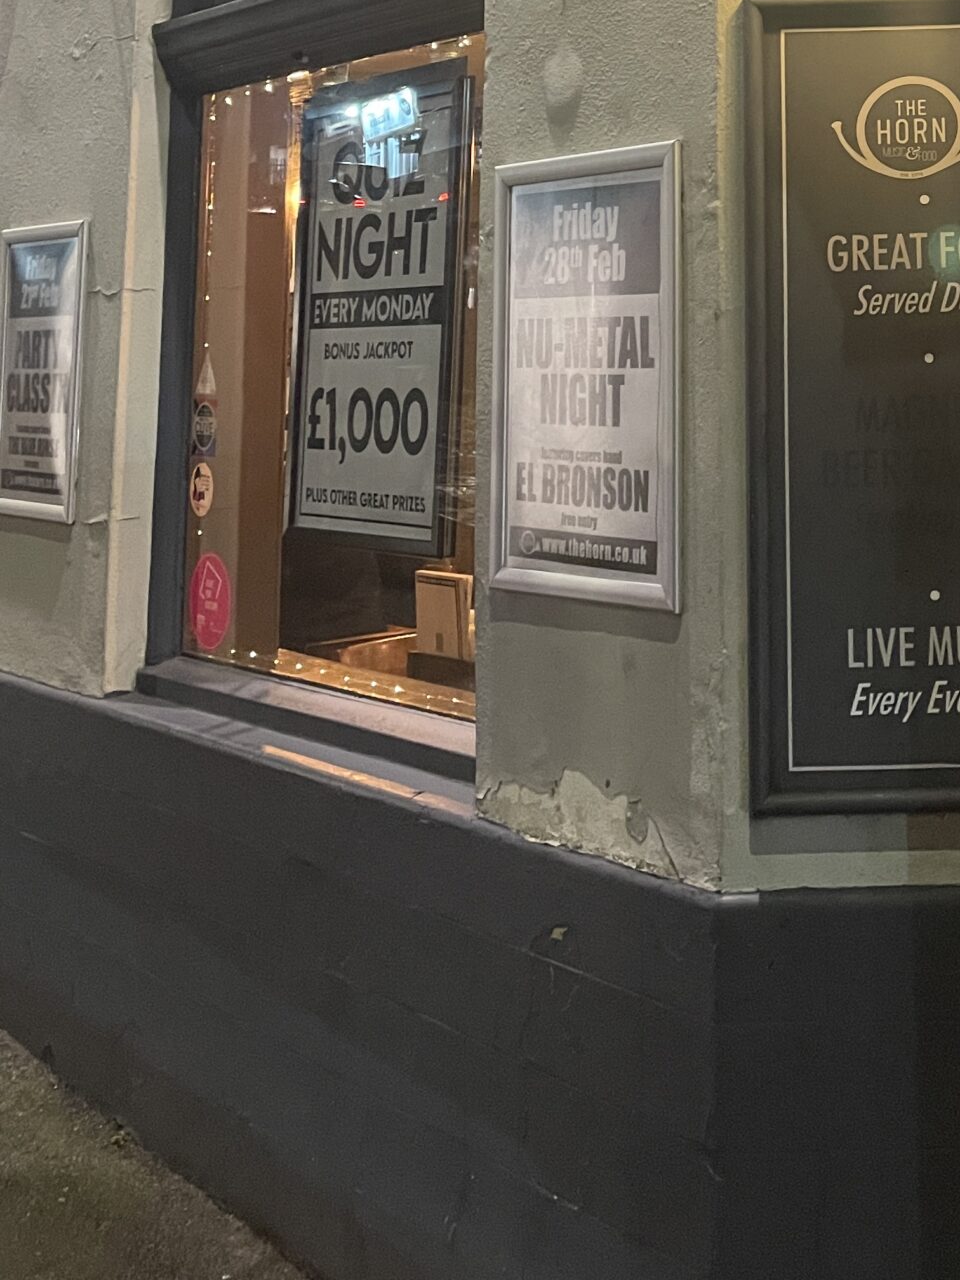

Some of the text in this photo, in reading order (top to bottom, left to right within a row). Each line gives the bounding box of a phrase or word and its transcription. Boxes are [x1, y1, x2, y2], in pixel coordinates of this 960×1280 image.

[895, 99, 927, 116] THE
[877, 117, 946, 145] HORN
[553, 202, 619, 242] Friday
[317, 208, 438, 282] NIGHT
[543, 243, 626, 286] 28th Feb
[826, 232, 928, 273] GREAT
[314, 292, 434, 324] EVERY MONDAY
[854, 281, 937, 317] Served
[324, 341, 414, 360] BONUS JACKPOT
[516, 316, 655, 369] NU-METAL
[540, 373, 625, 427] NIGHT
[307, 387, 429, 465] £1,000
[306, 487, 426, 513] PLUS OTHER GREAT PRIZES
[516, 462, 649, 513] EL BRONSON
[542, 537, 647, 565] www.thehorn.co.uk
[847, 626, 916, 669] LIVE
[850, 682, 922, 723] Every
